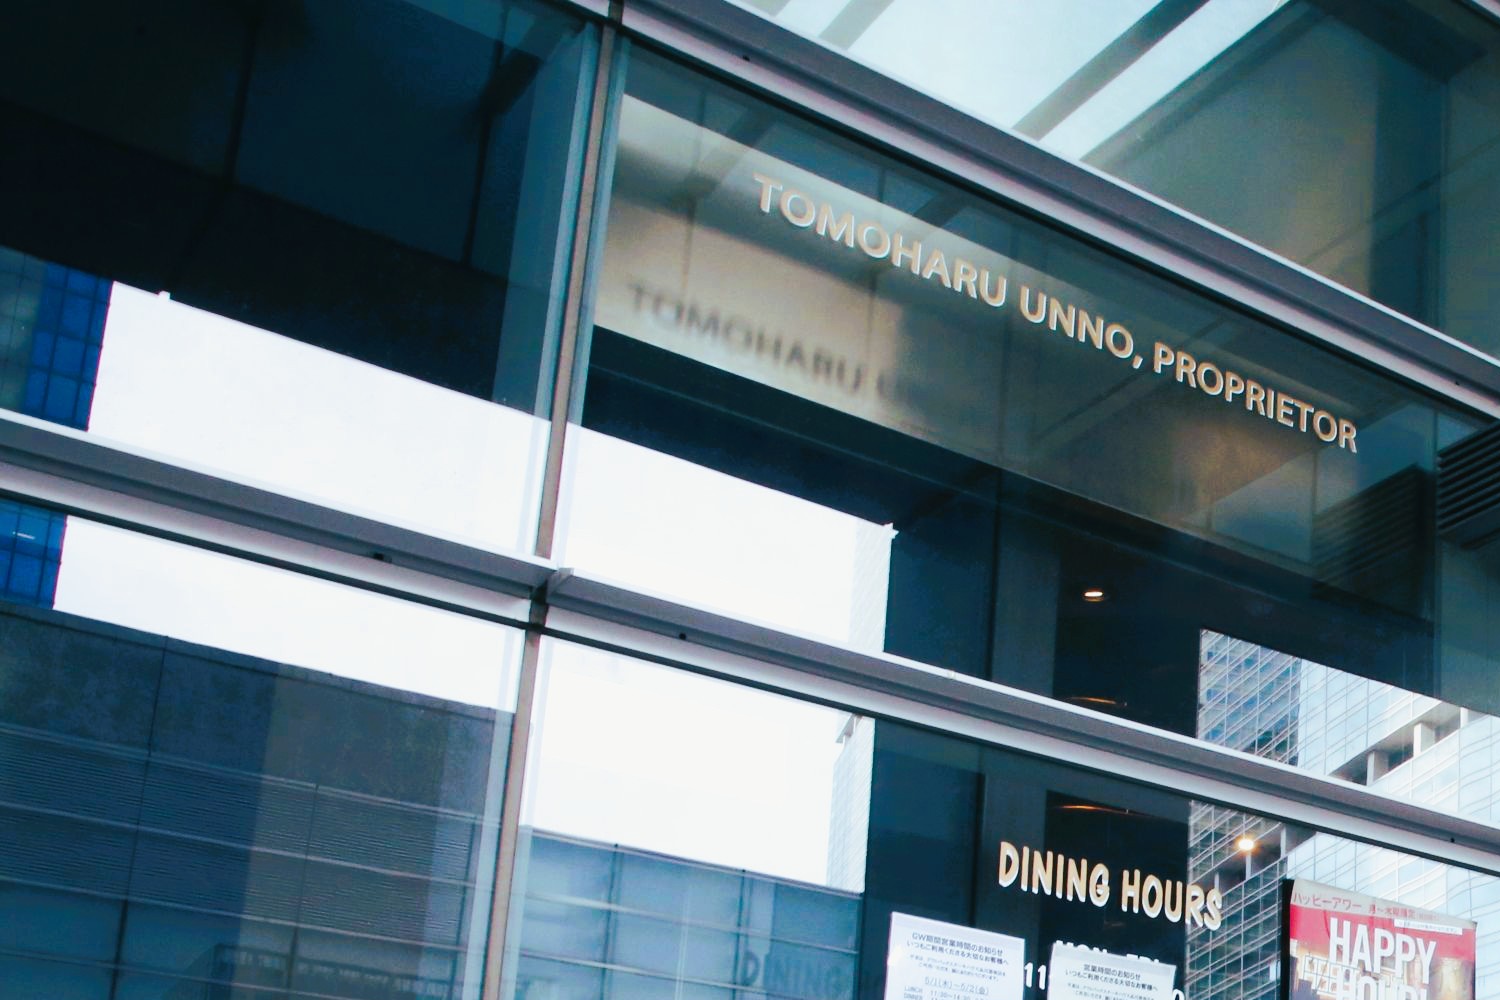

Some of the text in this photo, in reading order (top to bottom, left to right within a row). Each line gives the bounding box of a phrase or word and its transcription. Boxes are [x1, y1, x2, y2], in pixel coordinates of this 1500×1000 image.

[754, 172, 1358, 453] TOMOHARU UNNO, PROPRIETOR
[998, 841, 1223, 931] DINING HOURS
[1292, 892, 1362, 912] ハッピーアワー
[1024, 962, 1047, 990] 11
[1329, 917, 1437, 984] HAPPY
